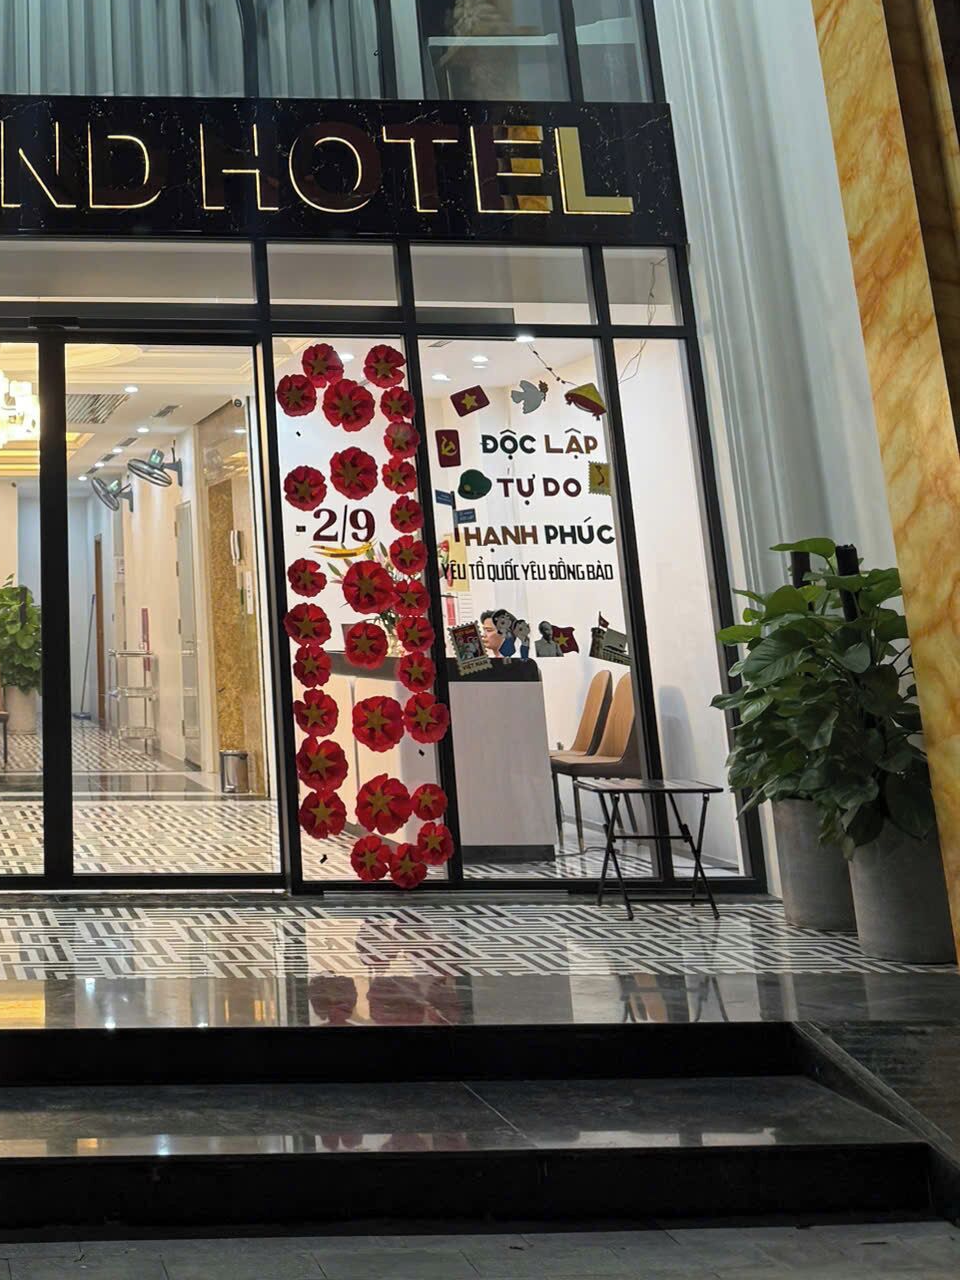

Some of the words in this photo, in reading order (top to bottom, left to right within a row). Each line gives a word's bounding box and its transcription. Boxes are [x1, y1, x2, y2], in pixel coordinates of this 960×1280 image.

[198, 120, 635, 216] HOTEL
[480, 428, 537, 460] ĐỘC
[544, 427, 599, 460] LẬP
[496, 473, 536, 506] TỰ
[542, 476, 583, 498] DO
[312, 504, 377, 544] 2/9
[463, 524, 539, 554] HẠNH
[544, 516, 616, 545] PHÚC
[441, 559, 467, 580] YÊU
[468, 556, 486, 581] TỔ
[486, 558, 520, 582] QUỐC
[520, 560, 547, 581] YÊU
[548, 557, 586, 581] ĐỒNG
[586, 559, 614, 581] BÀO
